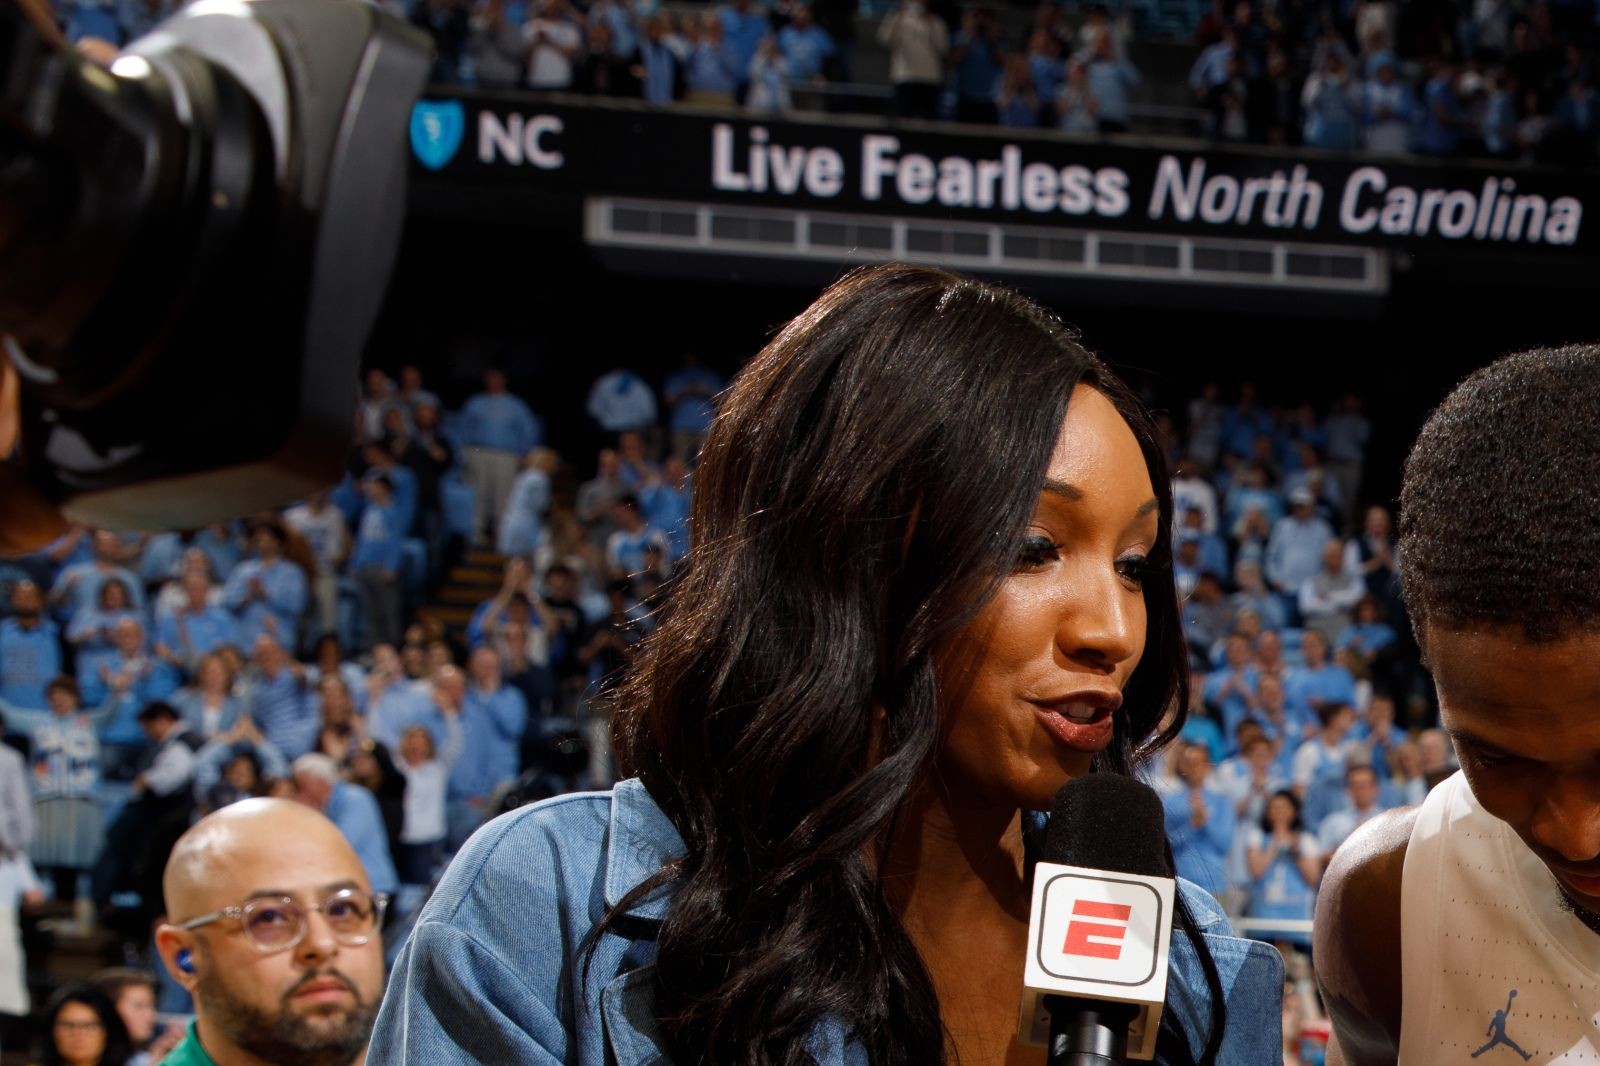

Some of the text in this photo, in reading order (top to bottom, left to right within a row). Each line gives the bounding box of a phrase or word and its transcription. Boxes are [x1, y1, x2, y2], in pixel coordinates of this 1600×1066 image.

[478, 110, 565, 169] NC
[713, 123, 1583, 246] Live Fearless North Carolina
